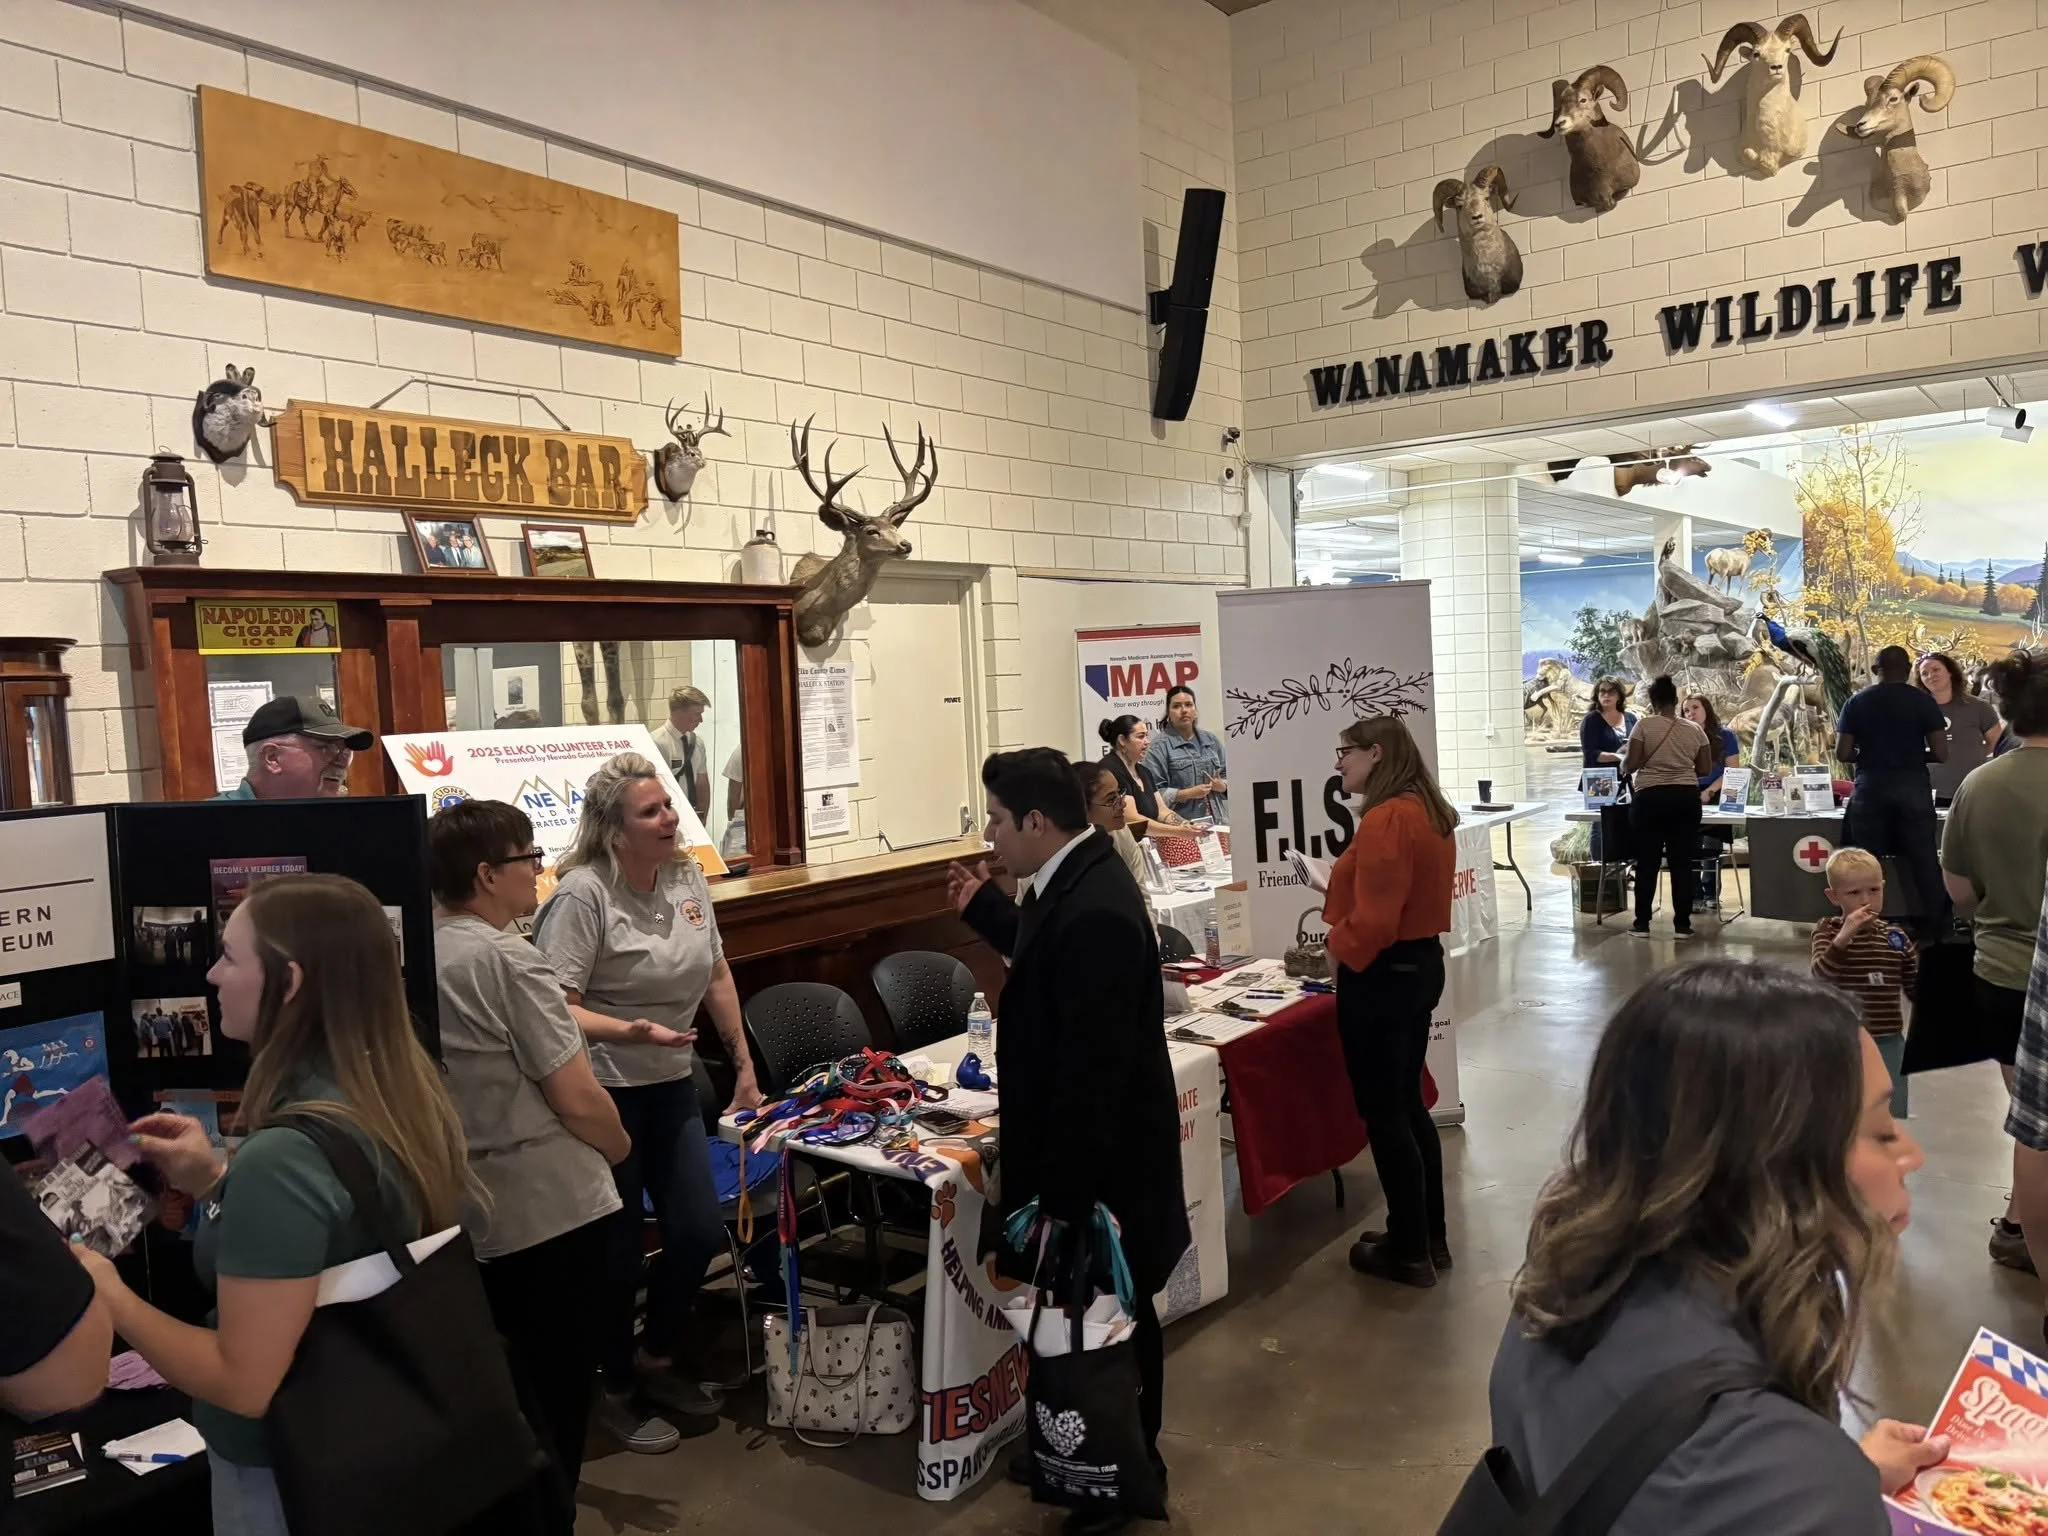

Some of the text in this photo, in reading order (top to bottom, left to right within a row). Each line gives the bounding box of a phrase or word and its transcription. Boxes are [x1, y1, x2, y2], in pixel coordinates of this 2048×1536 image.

[1310, 319, 1614, 406] WANAMAKER
[1659, 256, 1962, 351] WILDLIFE
[318, 416, 628, 511] HALLECK BAR
[202, 607, 306, 625] NAPOLEON
[222, 625, 294, 637] CIGAR
[824, 680, 845, 688] STATION
[1110, 660, 1199, 698] MAP
[1141, 699, 1165, 707] through
[467, 740, 633, 758] 2025 ELKO VOLUNTEER FAIR
[495, 753, 535, 764] Presented
[535, 754, 546, 763] by
[546, 752, 577, 761] Nevada
[578, 751, 596, 759] Gold
[436, 787, 464, 797] LIONS
[213, 866, 243, 874] BECOME
[250, 865, 280, 873] MEMBER
[281, 864, 305, 872] TODAY!
[2, 930, 53, 953] EUM
[1434, 1018, 1450, 1028] goal
[940, 1237, 984, 1320] HELPING
